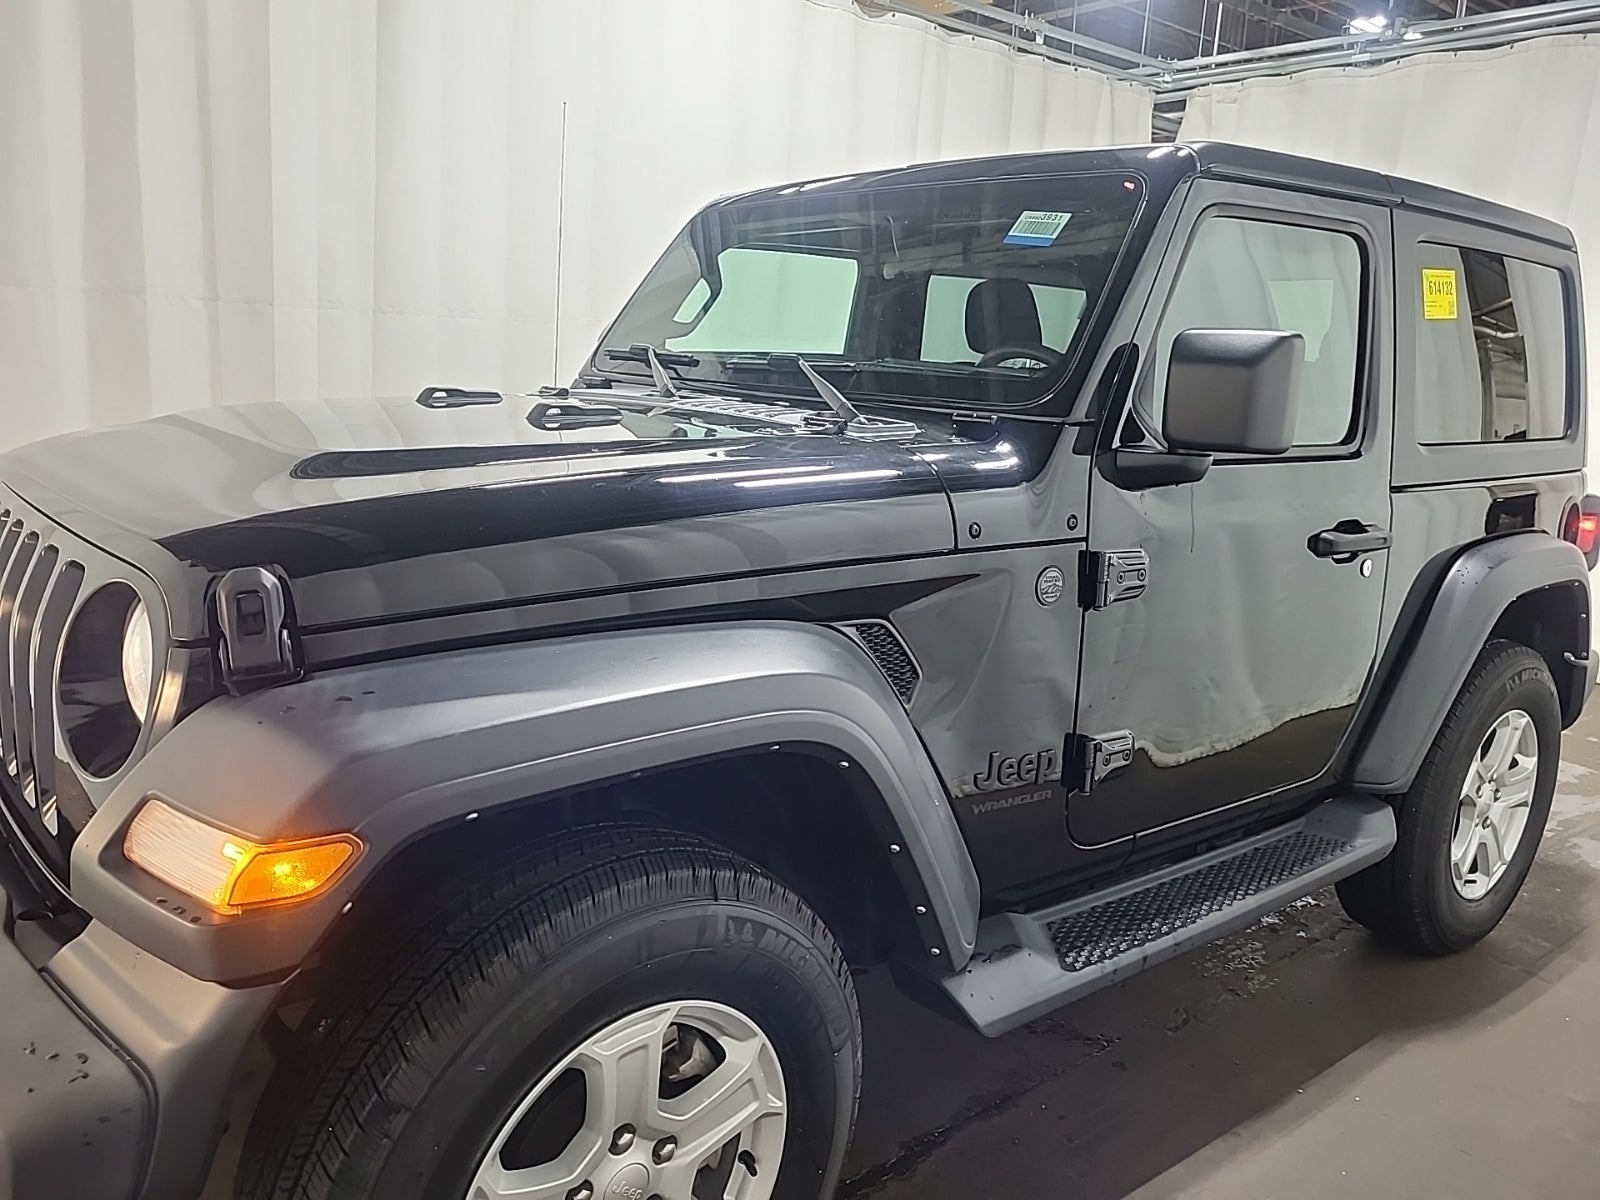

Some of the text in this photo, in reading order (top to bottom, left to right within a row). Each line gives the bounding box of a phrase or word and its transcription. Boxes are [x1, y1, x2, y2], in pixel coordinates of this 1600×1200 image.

[1428, 280, 1453, 296] 614132
[973, 749, 1058, 791] Jeep
[972, 790, 1053, 815] WRANGLER
[612, 1180, 643, 1200] Jeep
